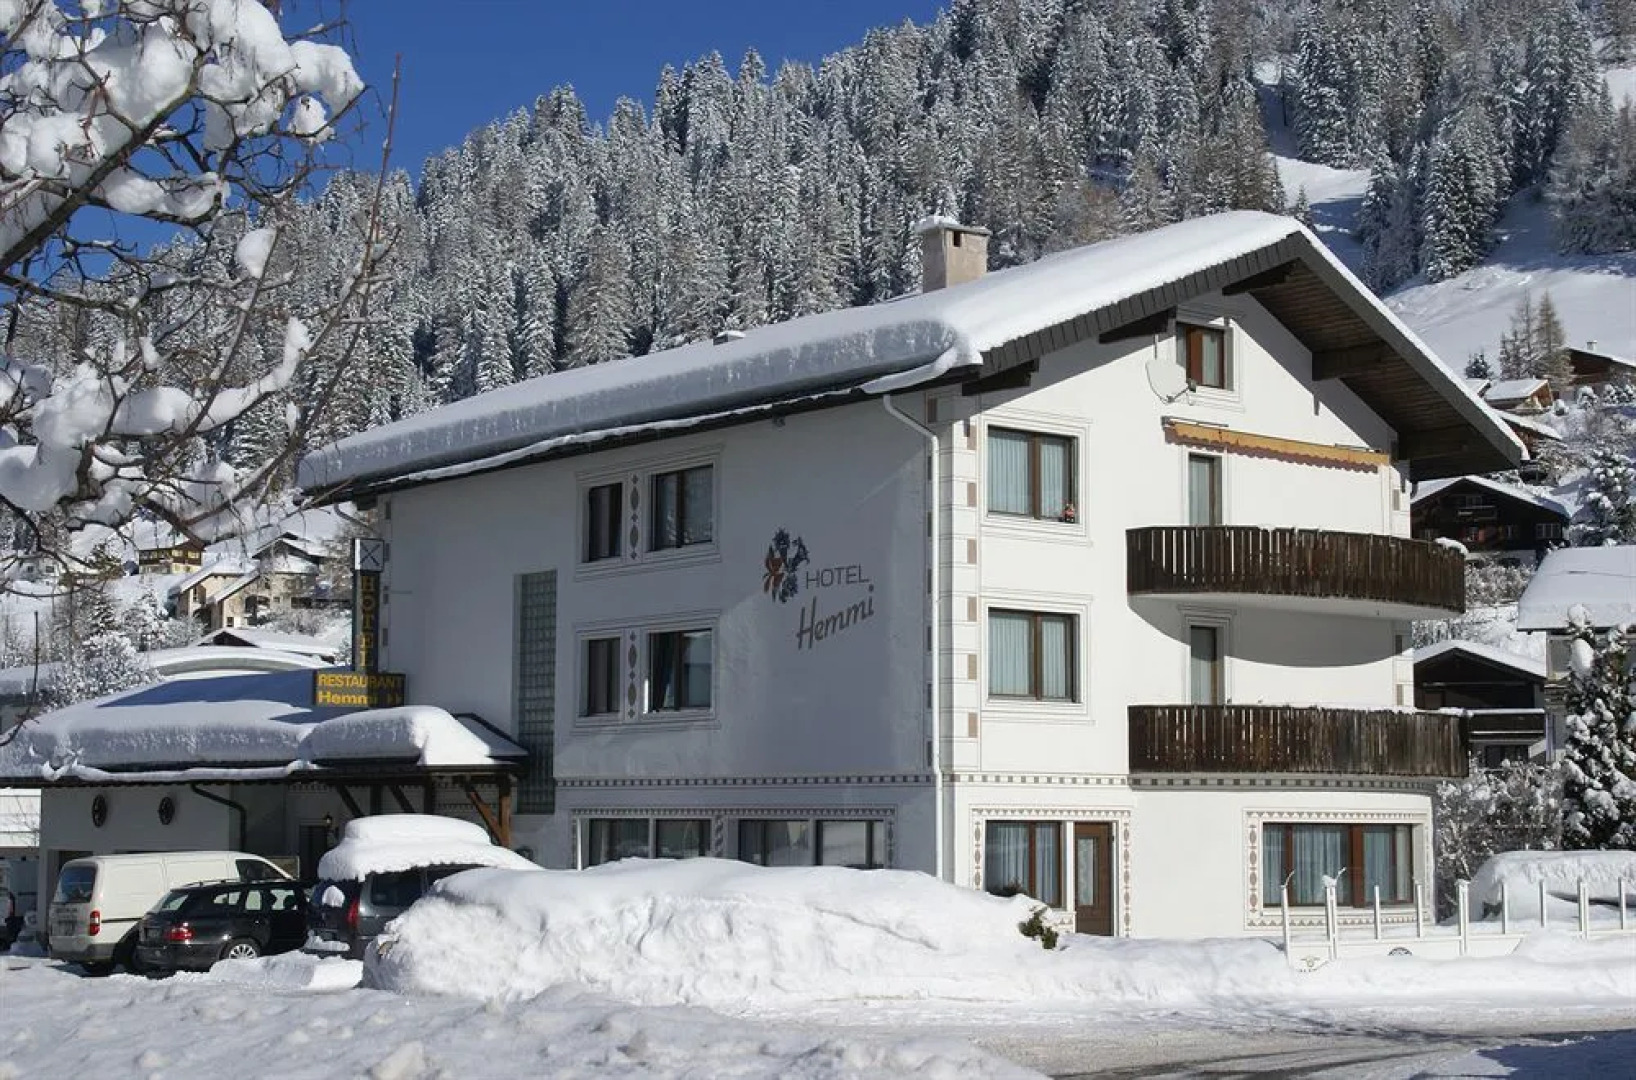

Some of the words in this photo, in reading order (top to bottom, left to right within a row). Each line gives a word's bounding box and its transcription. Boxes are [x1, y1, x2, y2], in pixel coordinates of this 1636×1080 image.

[806, 564, 869, 589] HOTEL
[360, 575, 375, 667] HOTEL
[797, 584, 874, 650] Hemmi
[318, 673, 403, 689] RESTAURANT
[318, 690, 378, 705] Hemmi
